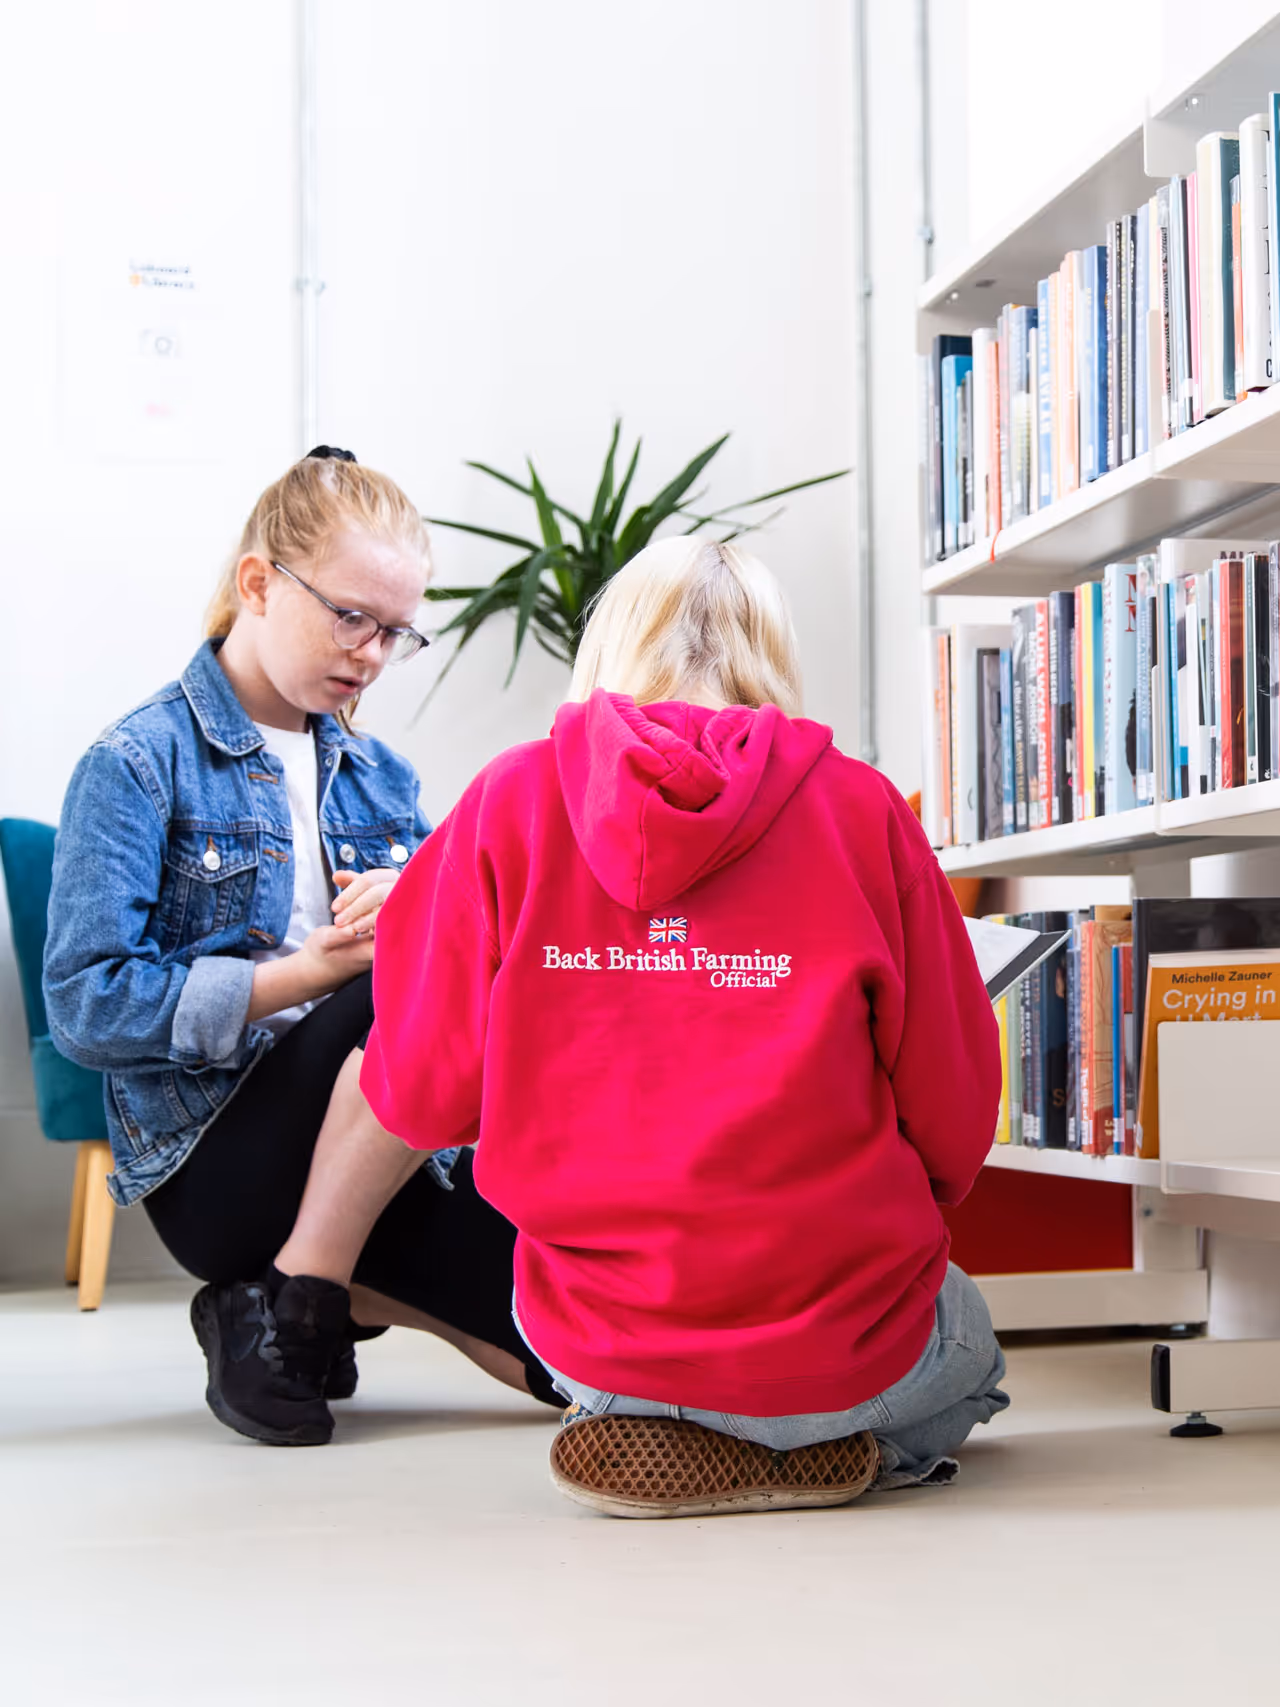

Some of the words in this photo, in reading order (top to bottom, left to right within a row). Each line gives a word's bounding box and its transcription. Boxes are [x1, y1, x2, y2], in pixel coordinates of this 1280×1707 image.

[542, 945, 602, 971] Back
[606, 946, 686, 972] British
[691, 947, 792, 978] Farming
[710, 971, 777, 988] Official
[1171, 970, 1225, 984] Michelle
[1228, 970, 1273, 982] Zauner
[1162, 987, 1247, 1012] Crying
[1254, 984, 1276, 1004] in
